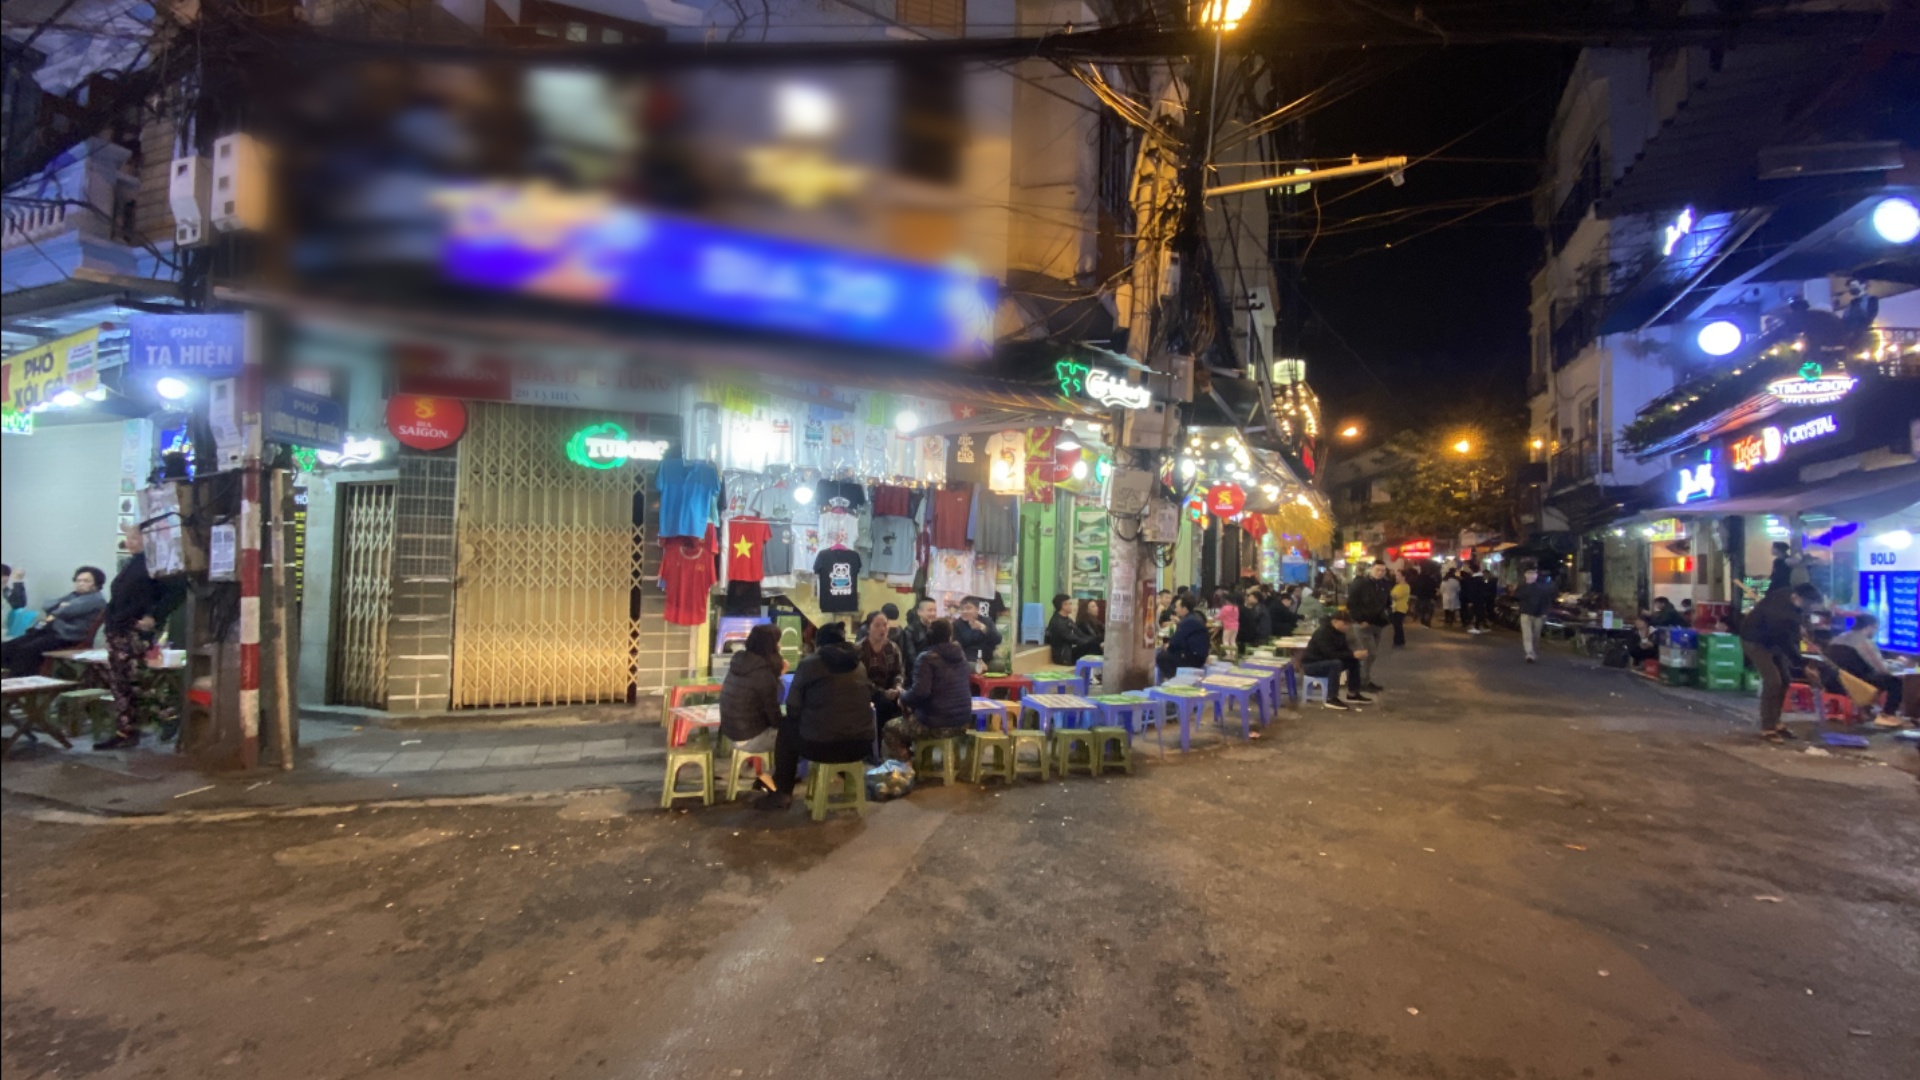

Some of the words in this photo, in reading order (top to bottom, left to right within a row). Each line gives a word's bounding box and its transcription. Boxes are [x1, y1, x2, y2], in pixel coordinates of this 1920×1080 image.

[180, 340, 235, 368] HIỆN
[399, 425, 449, 439] SAIGON
[1732, 435, 1763, 471] Tiger
[1788, 415, 1837, 443] CRYSTAL
[1869, 551, 1897, 565] BOLD
